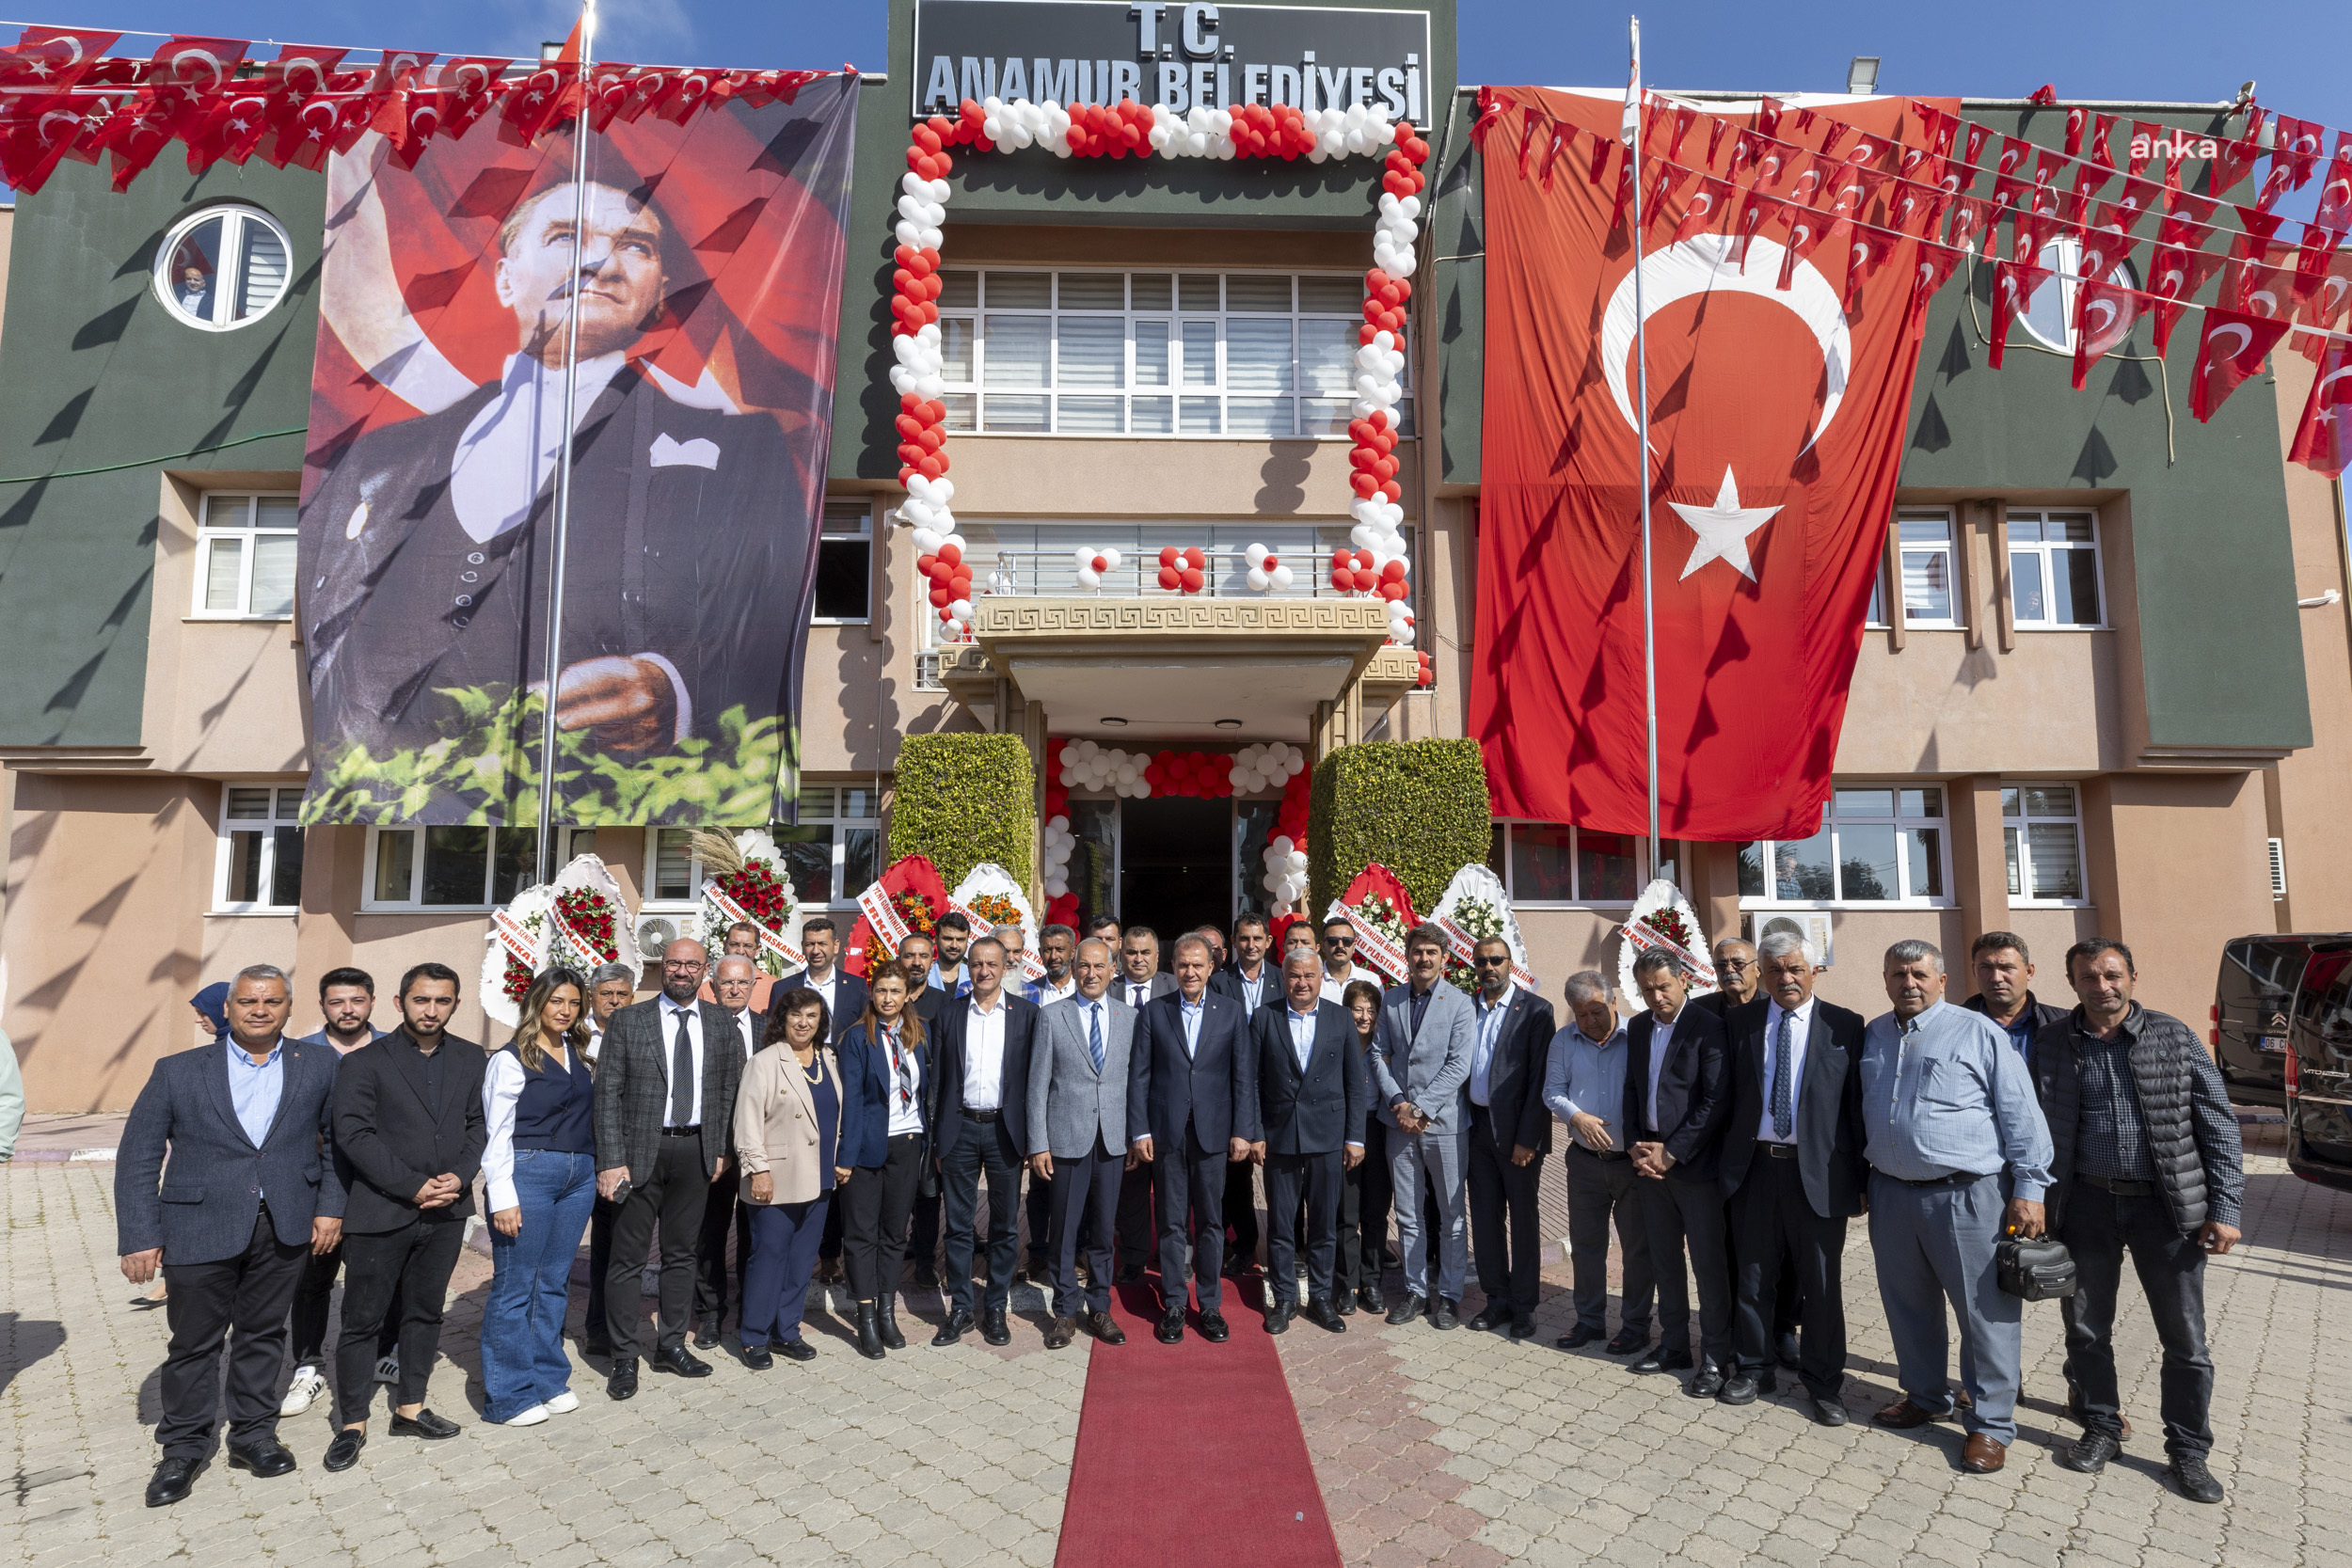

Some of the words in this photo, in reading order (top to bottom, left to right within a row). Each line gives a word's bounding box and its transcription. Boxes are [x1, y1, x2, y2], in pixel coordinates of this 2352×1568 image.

[925, 55, 1140, 110] ANAMUR
[708, 885, 723, 899] CHP
[718, 894, 746, 923] ANAMUR
[872, 886, 885, 902] YENİ
[880, 899, 908, 939] GÖREVİNİZDE
[949, 900, 979, 927] YAPARSA
[1336, 905, 1350, 919] YENİ
[1348, 914, 1386, 947] GÖREVİNİZDE
[1439, 916, 1477, 949] GÖREVİNİZDE
[1366, 944, 1397, 972] PLASTİK
[1395, 968, 1402, 977] &
[1634, 922, 1656, 940] GÜNLER
[1682, 951, 1701, 968] HAYIRLI
[1698, 963, 1716, 977] OLSUN
[2265, 1037, 2275, 1049] 06
